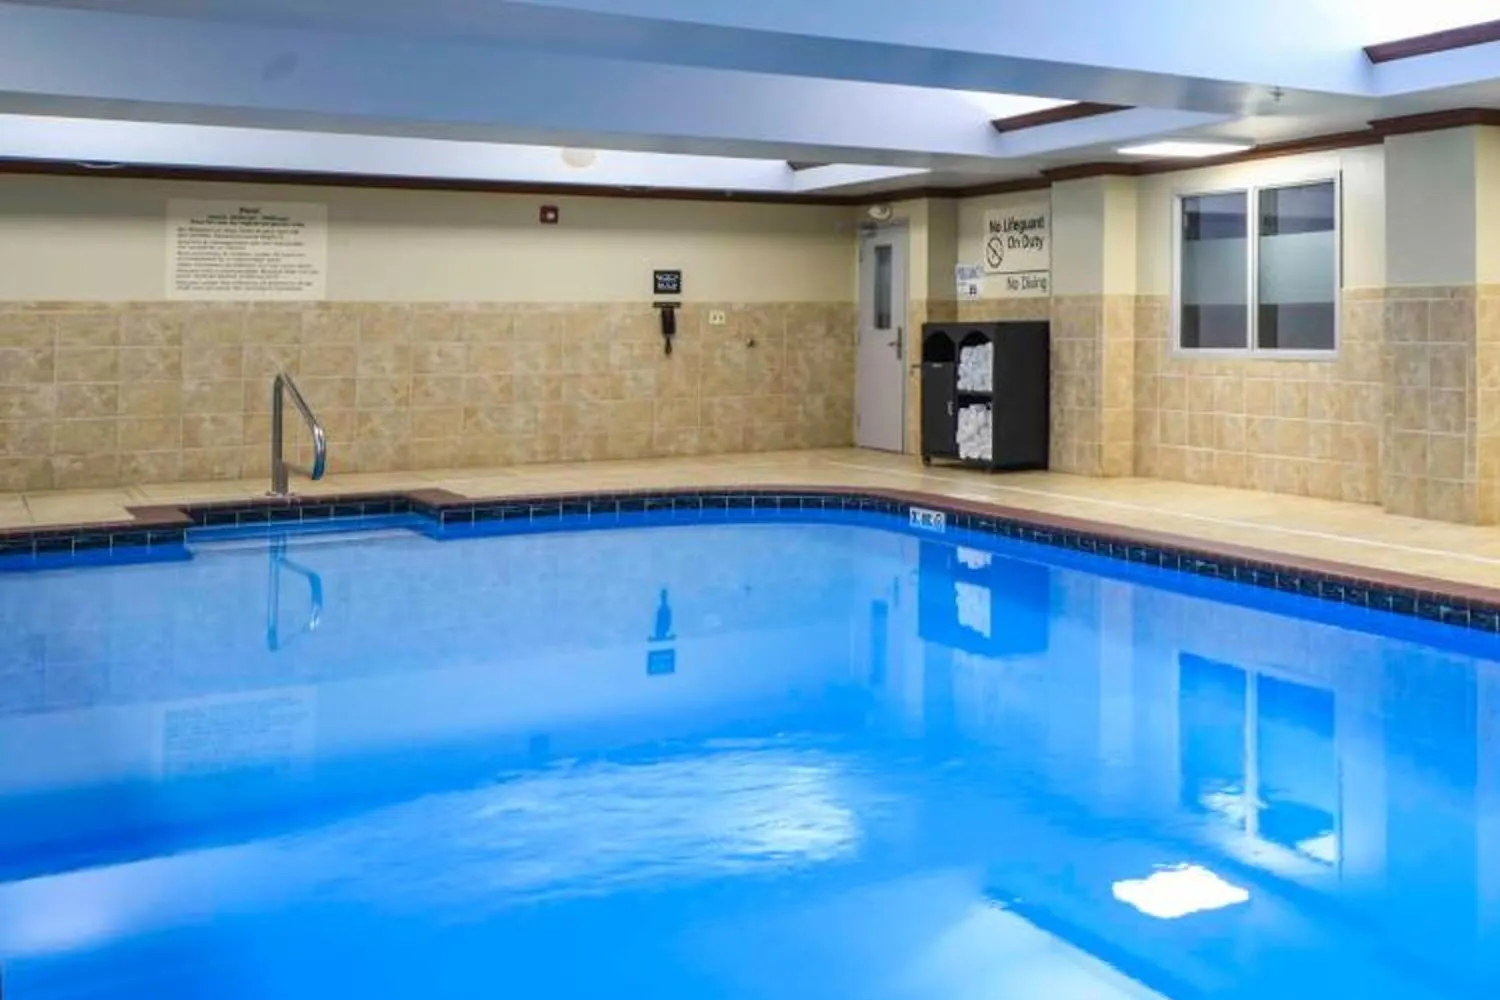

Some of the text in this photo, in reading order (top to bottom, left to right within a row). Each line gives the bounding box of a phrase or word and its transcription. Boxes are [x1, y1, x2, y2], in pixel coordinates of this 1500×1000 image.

[989, 216, 1045, 234] No Lifeguard
[1007, 234, 1043, 251] On Duty
[1007, 276, 1018, 290] No
